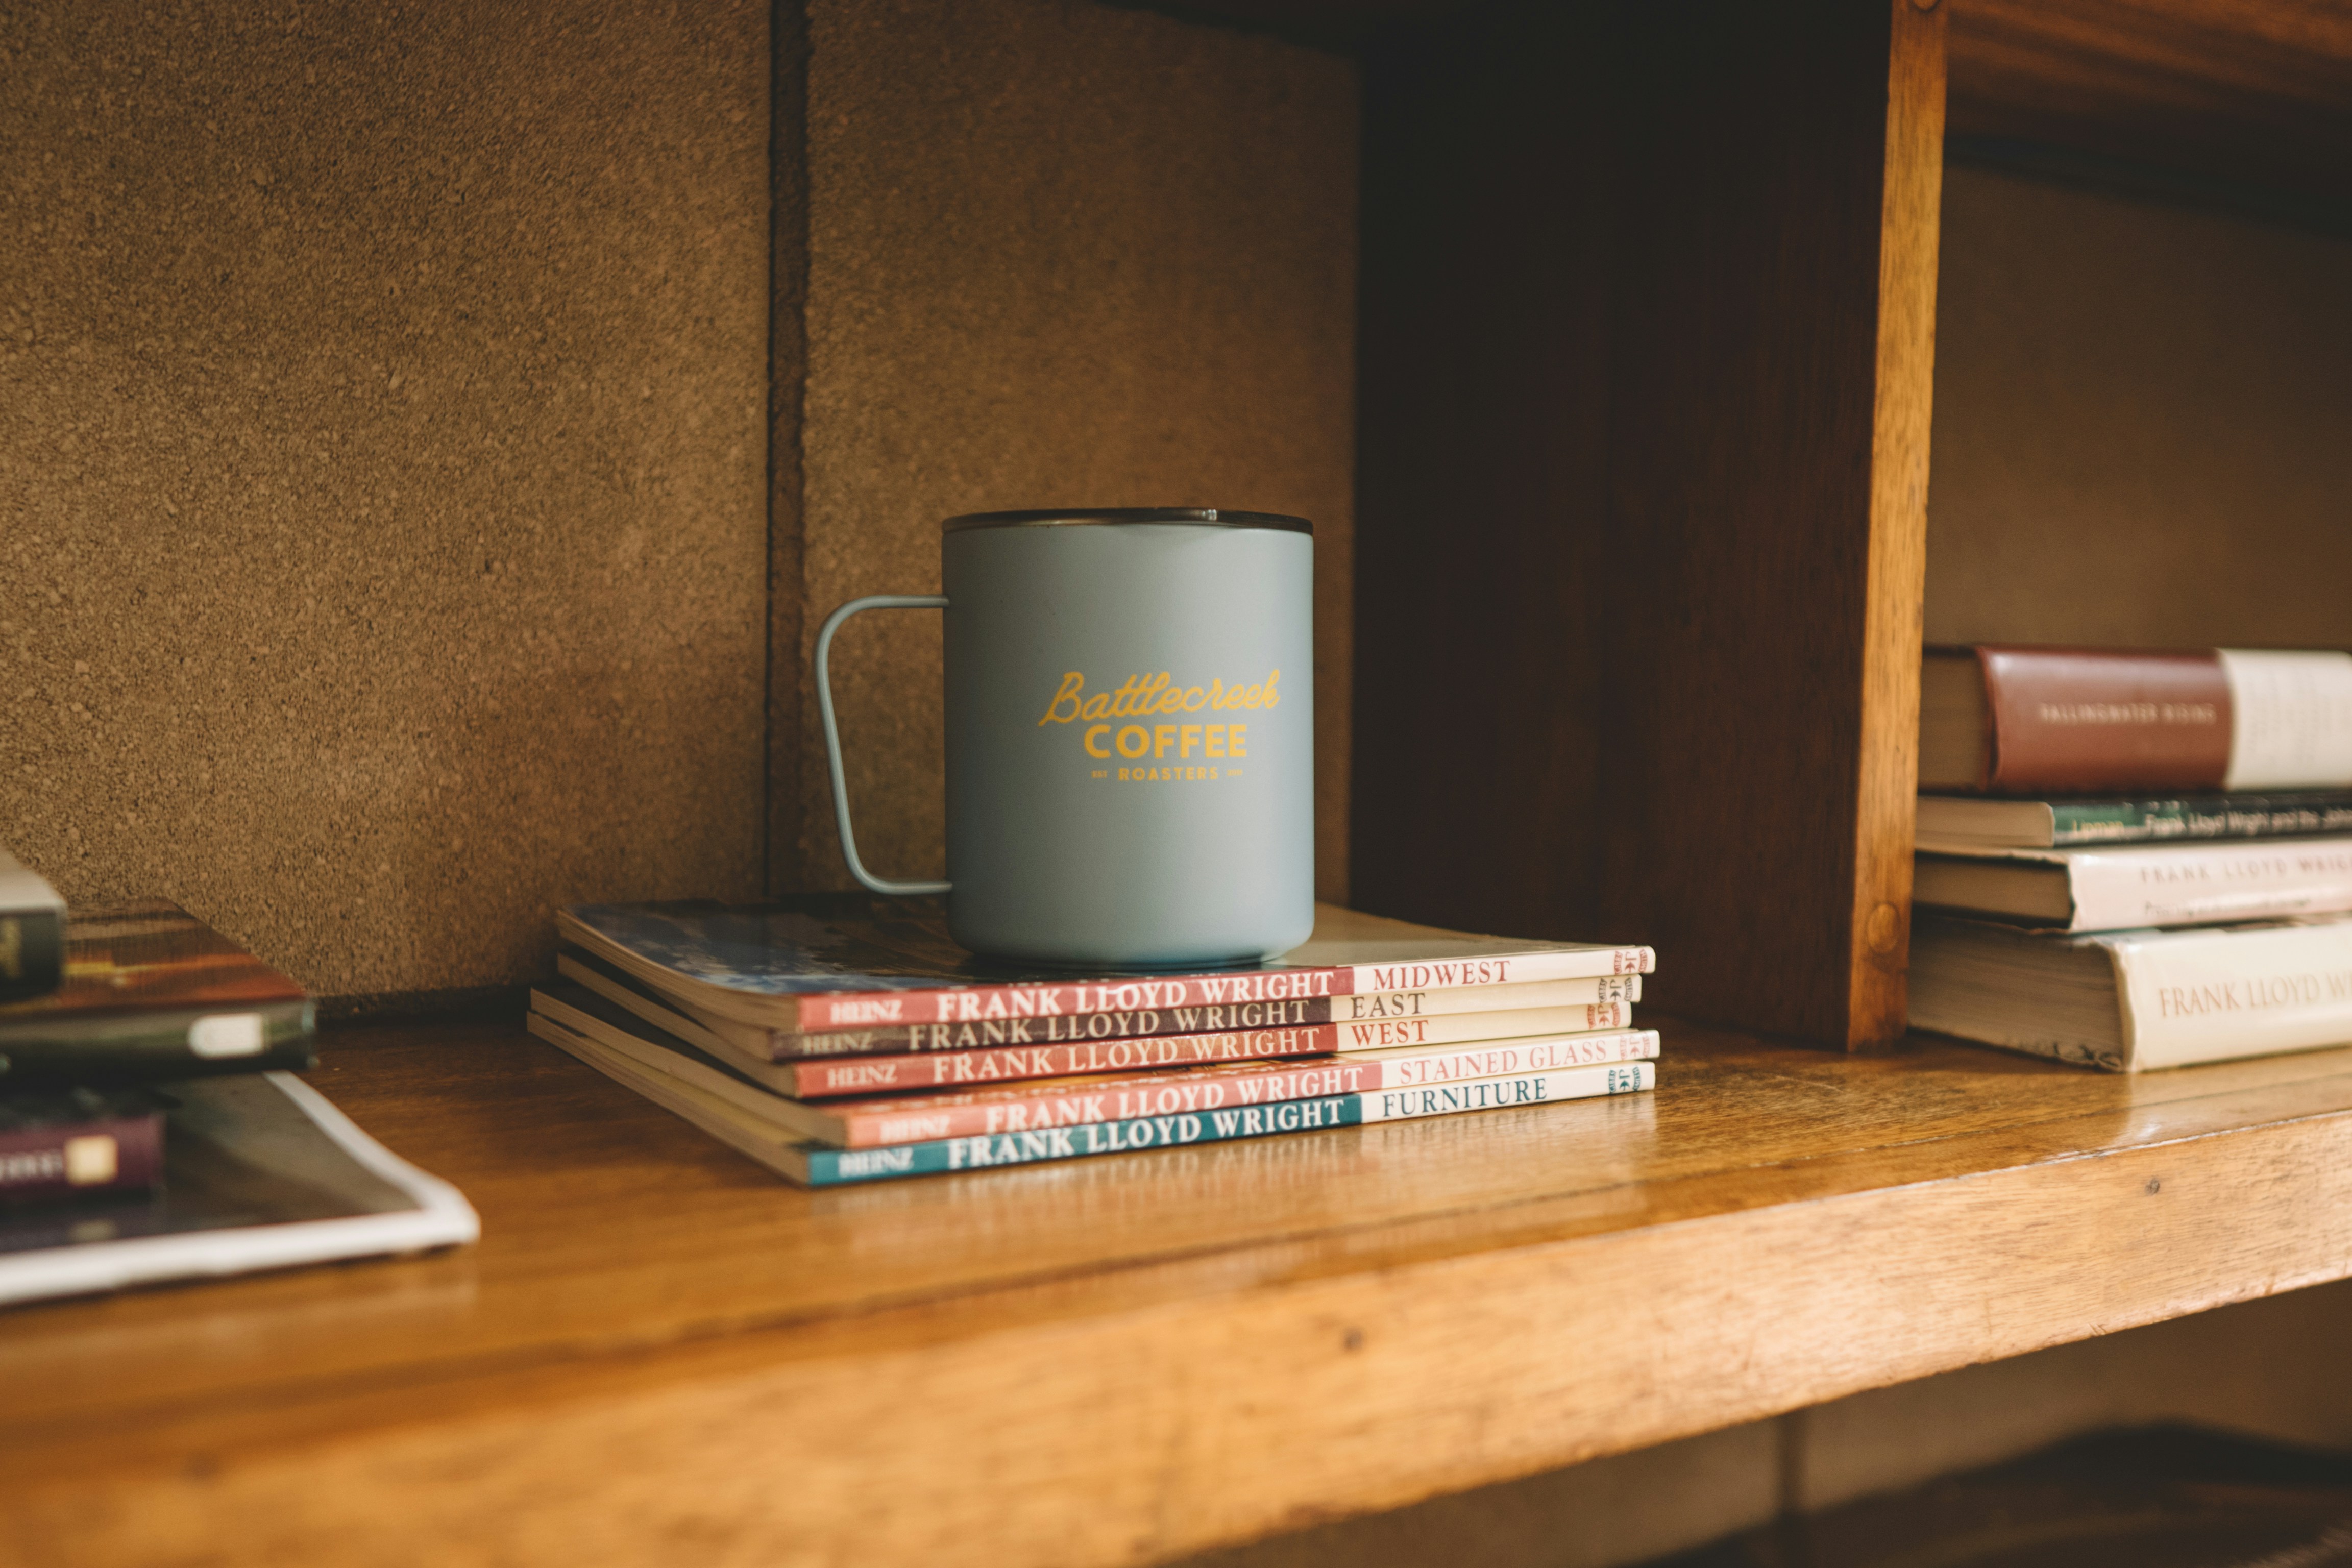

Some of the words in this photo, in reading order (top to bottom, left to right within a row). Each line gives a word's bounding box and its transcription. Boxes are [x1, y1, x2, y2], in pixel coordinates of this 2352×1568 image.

[1038, 669, 1280, 727] Battlecreek
[1084, 724, 1247, 759] COFFEE
[1118, 767, 1218, 781] ROASTERS
[2141, 864, 2211, 884] FRANK
[2224, 857, 2287, 879] LLOYD
[830, 999, 903, 1025] HEINZ
[936, 987, 1062, 1022] FRANK
[1076, 981, 1187, 1015] LLOYD
[1200, 971, 1334, 1005] WRIGHT
[1374, 960, 1511, 991] MIDWEST
[2159, 982, 2241, 1017] FRANK
[2246, 973, 2321, 1008] LLOYD
[802, 1032, 874, 1055] HEINZ
[909, 1019, 1034, 1051] FRANK
[1047, 1010, 1160, 1041] LLOYD
[1174, 999, 1310, 1032] WRIGHT
[1350, 993, 1427, 1019] EAST
[827, 1064, 897, 1088] HEINZ
[933, 1048, 1054, 1083] FRANK
[1068, 1039, 1178, 1071] LLOYD
[1188, 1027, 1320, 1060] WRIGHT
[1351, 1020, 1429, 1047] WEST
[985, 1094, 1106, 1135] FRANK
[1118, 1082, 1226, 1119] LLOYD
[1236, 1067, 1364, 1101] WRIGHT
[1400, 1050, 1518, 1085] STAINED
[1529, 1040, 1607, 1069] GLASS
[838, 1146, 914, 1178] HEINZ
[947, 1126, 1074, 1170] FRANK
[1085, 1114, 1202, 1154] LLOYD
[1211, 1099, 1345, 1138] WRIGHT
[1383, 1077, 1548, 1117] FURNITURE
